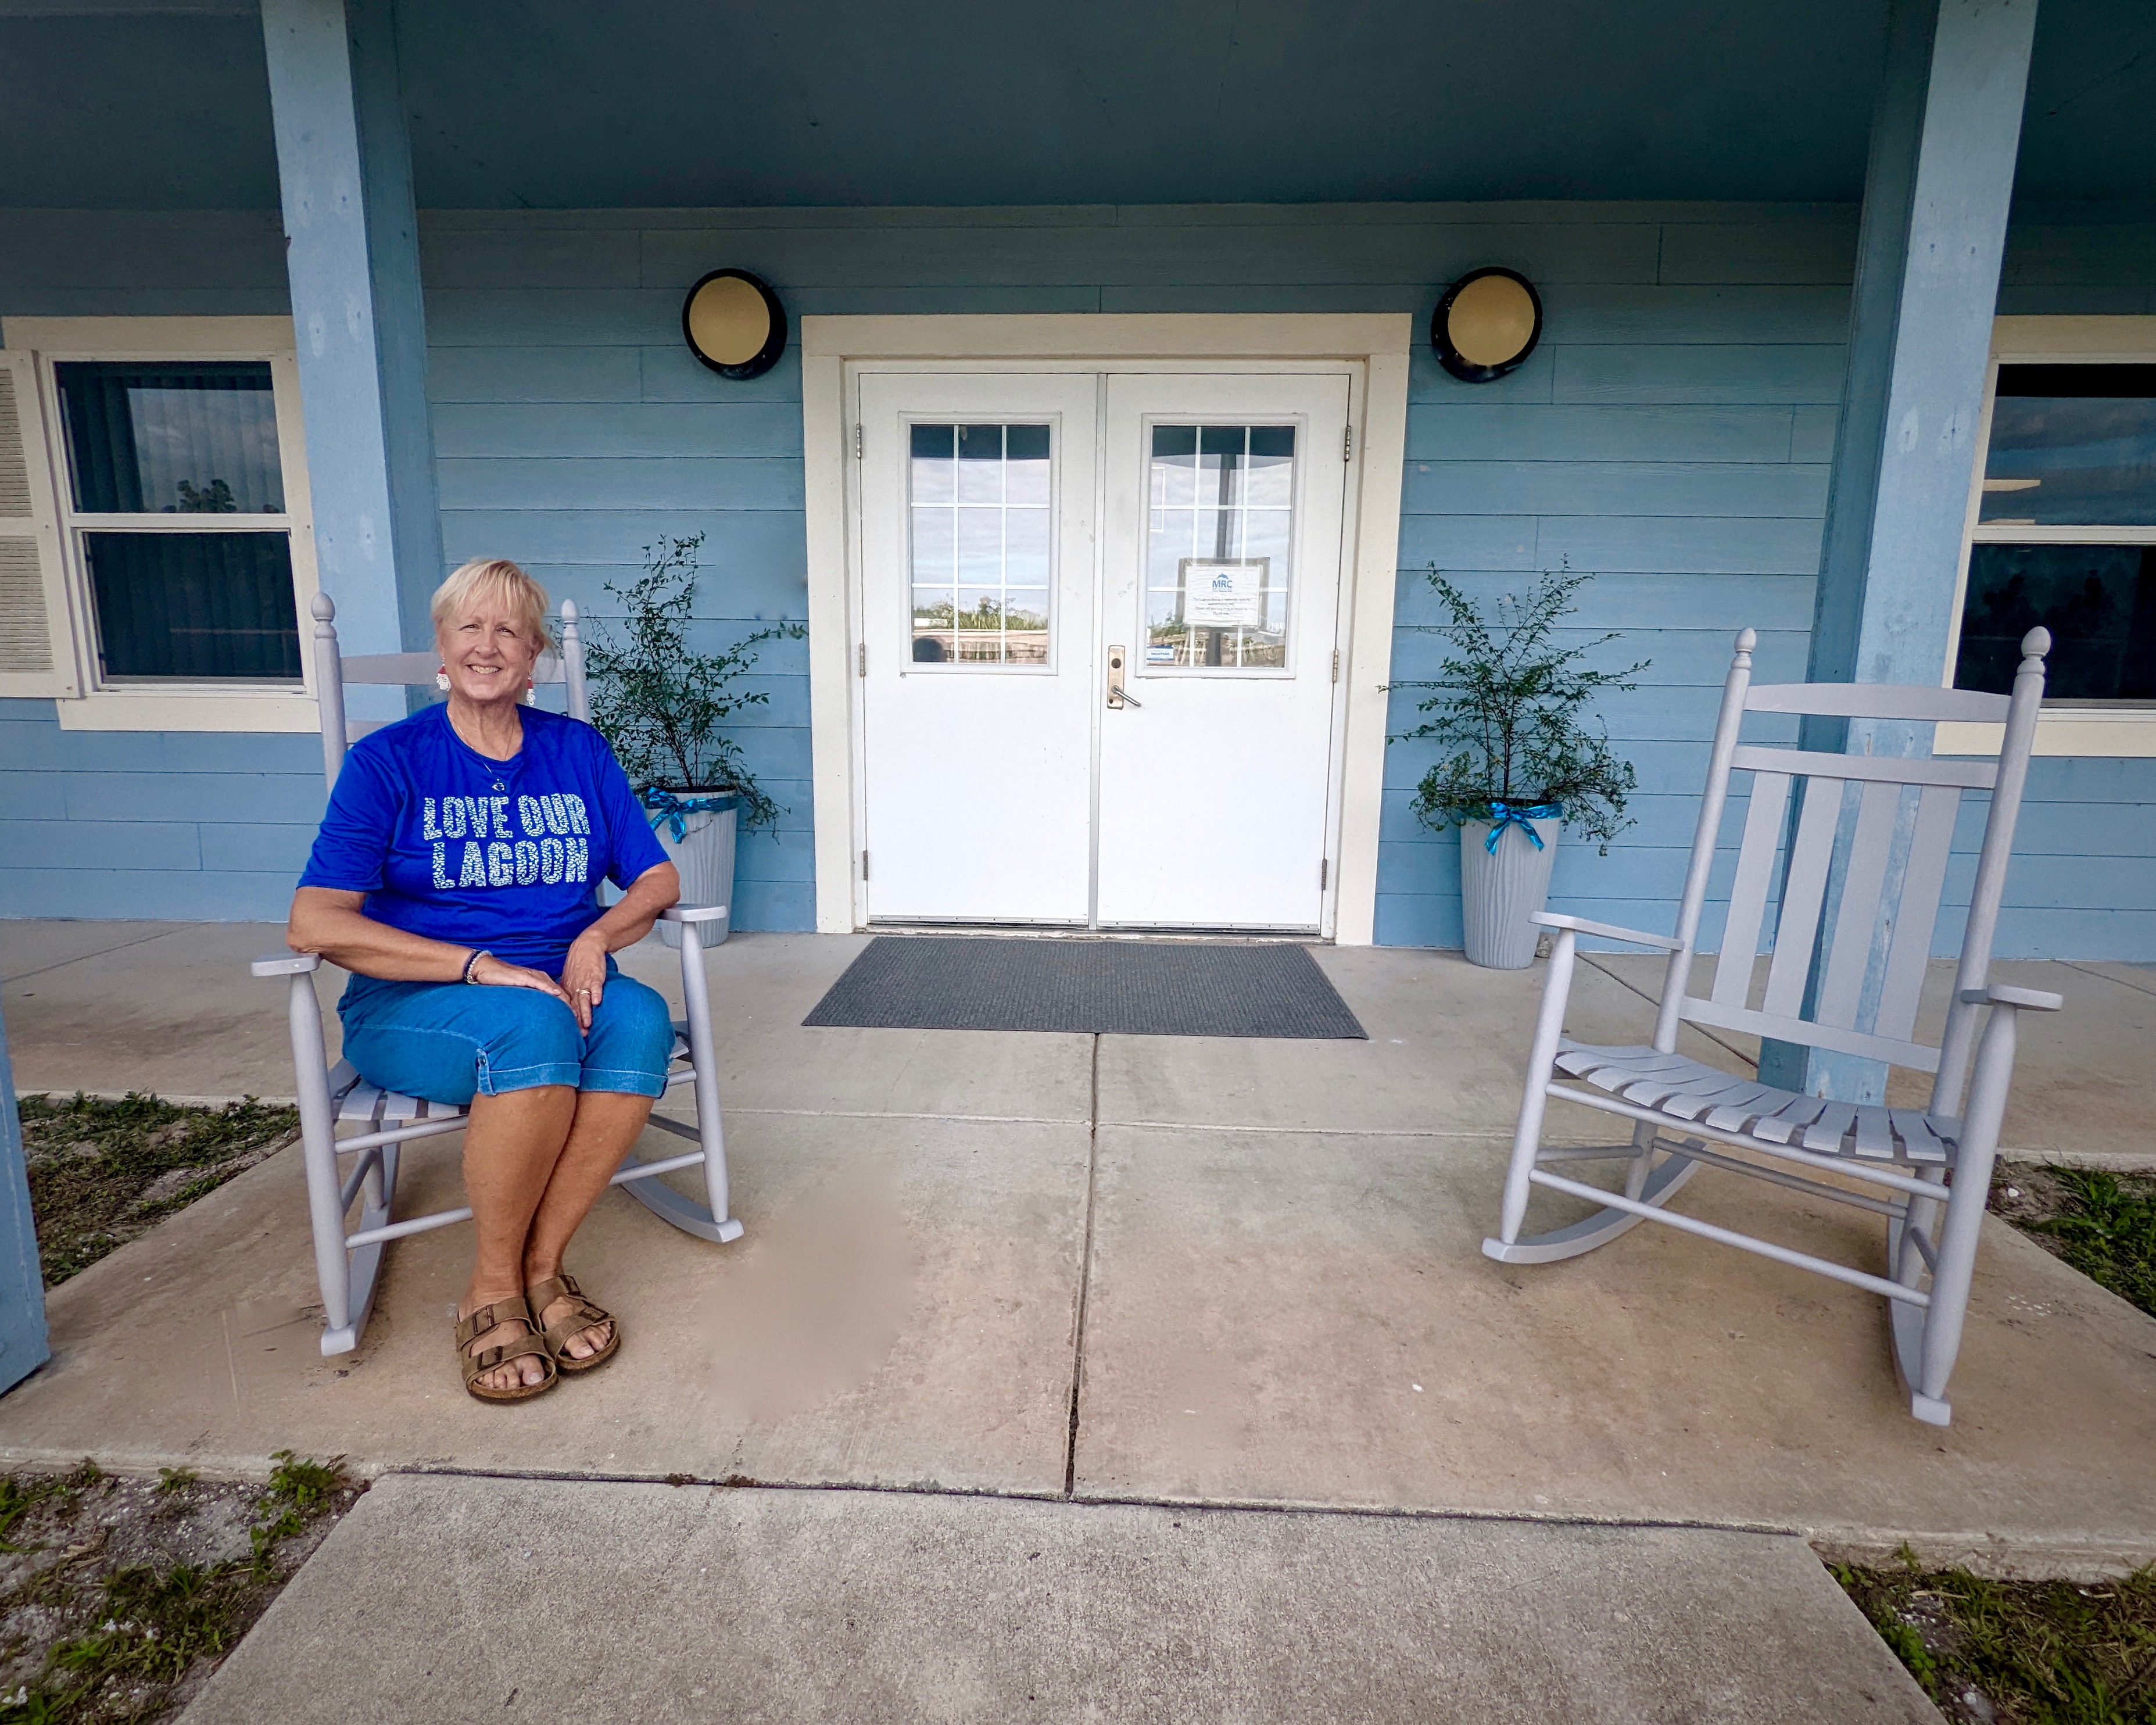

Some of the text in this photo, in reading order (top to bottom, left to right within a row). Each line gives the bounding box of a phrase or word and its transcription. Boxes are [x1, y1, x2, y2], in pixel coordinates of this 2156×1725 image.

[1212, 580, 1233, 588] MRC
[423, 793, 591, 840] LOVE OUR
[432, 837, 589, 889] LAGOON
